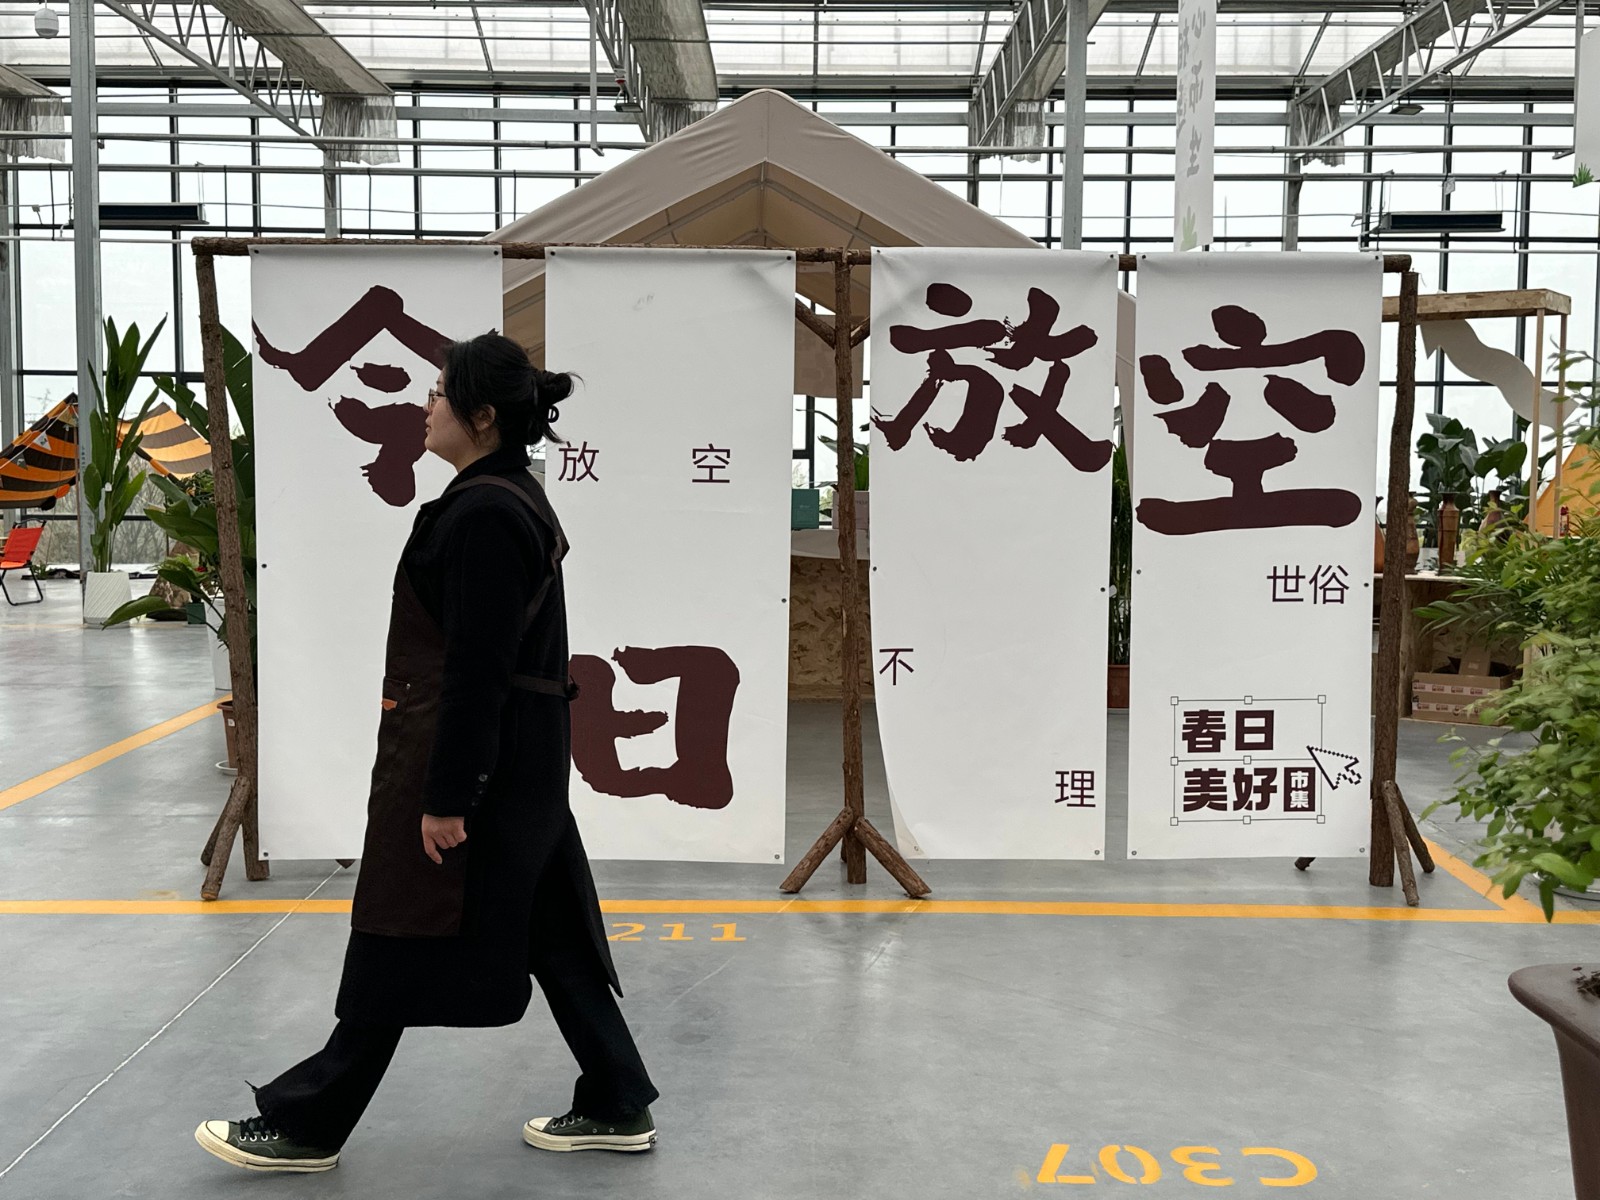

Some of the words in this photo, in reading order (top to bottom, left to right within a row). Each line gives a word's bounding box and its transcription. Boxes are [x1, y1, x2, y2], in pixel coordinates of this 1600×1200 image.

[251, 285, 498, 507] 今
[873, 283, 1114, 472] 放
[1137, 305, 1365, 535] 空
[557, 441, 600, 483] 放
[691, 443, 732, 484] 空
[1267, 564, 1350, 605] 世俗
[879, 647, 915, 686] 不
[568, 645, 741, 810] 日
[1181, 708, 1275, 754] 春日
[1055, 770, 1096, 808] 理
[1182, 767, 1278, 813] 美好
[1286, 767, 1313, 811] 市集
[1037, 1143, 1318, 1187] C307
